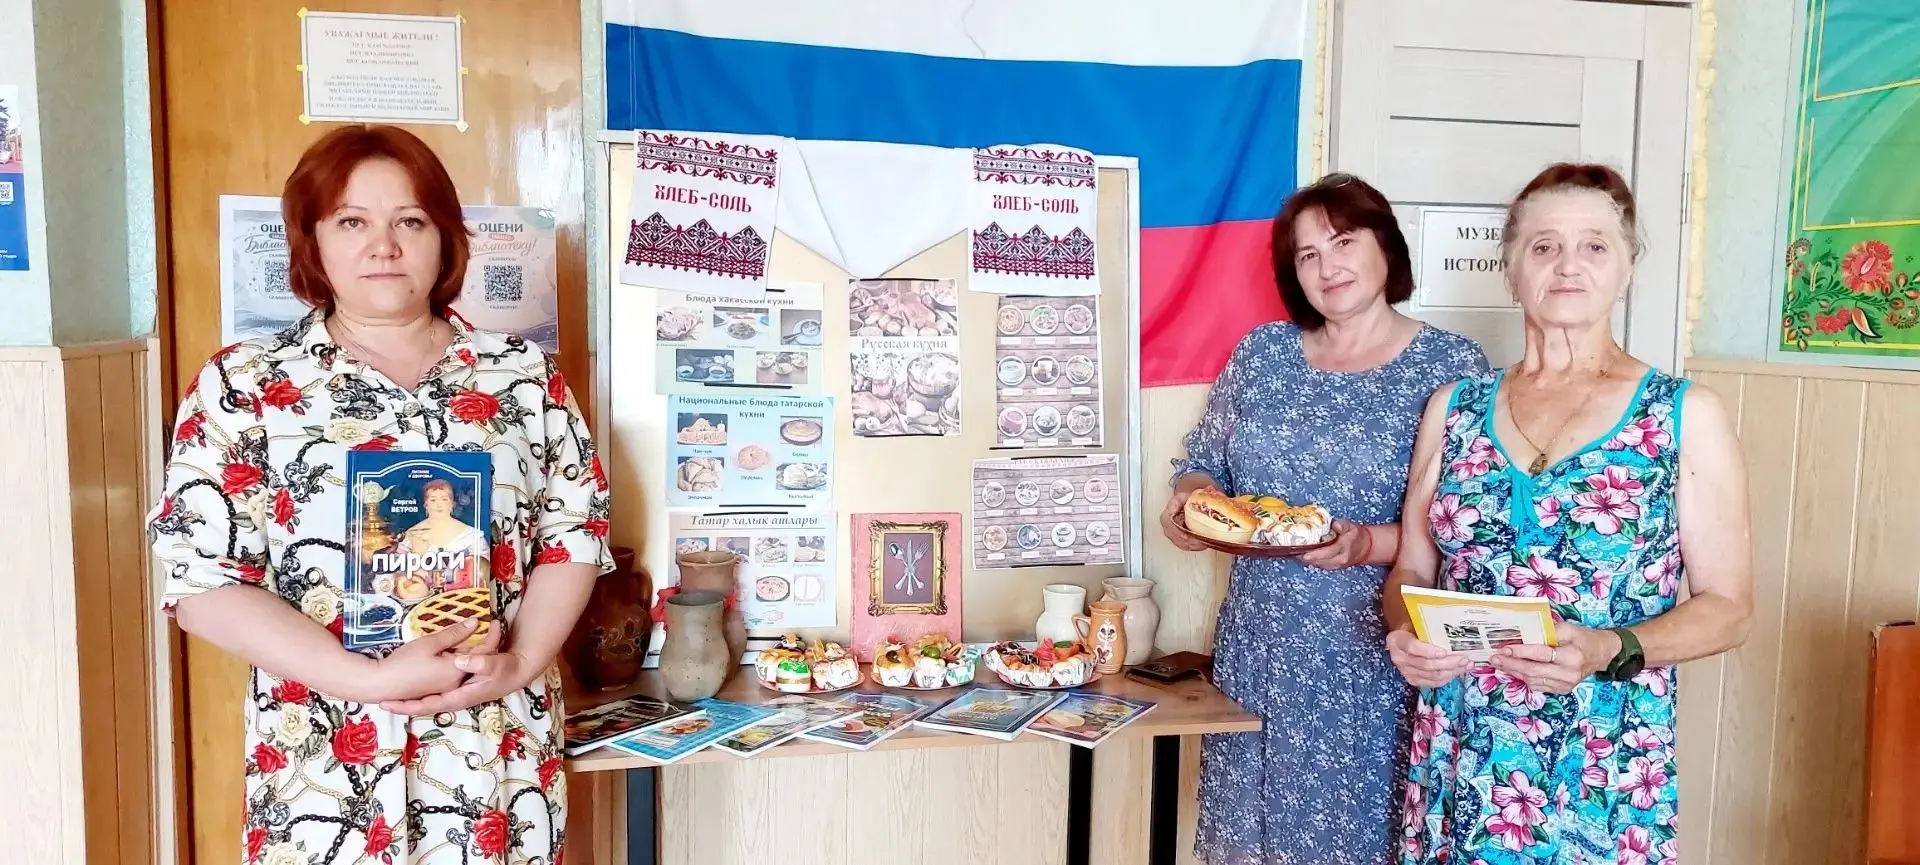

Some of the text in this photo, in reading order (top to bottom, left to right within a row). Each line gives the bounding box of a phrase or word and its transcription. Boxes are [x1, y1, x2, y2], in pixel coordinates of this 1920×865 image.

[655, 184, 752, 213] ХЛЕБ-СОЛЬ
[993, 194, 1079, 214] ХЛЕБ-СОЛЬ
[260, 223, 285, 233] ОЦЕ
[478, 222, 524, 233] ОЦЕНИ
[244, 234, 287, 254] Библио
[686, 293, 717, 304] Блюда
[767, 298, 794, 307] кухни
[861, 338, 910, 351] Русская
[679, 396, 824, 409] Национальные блюда татарской
[739, 411, 765, 419] кухни
[392, 498, 417, 506] Сергей
[690, 515, 818, 528] Татар халык ашлары
